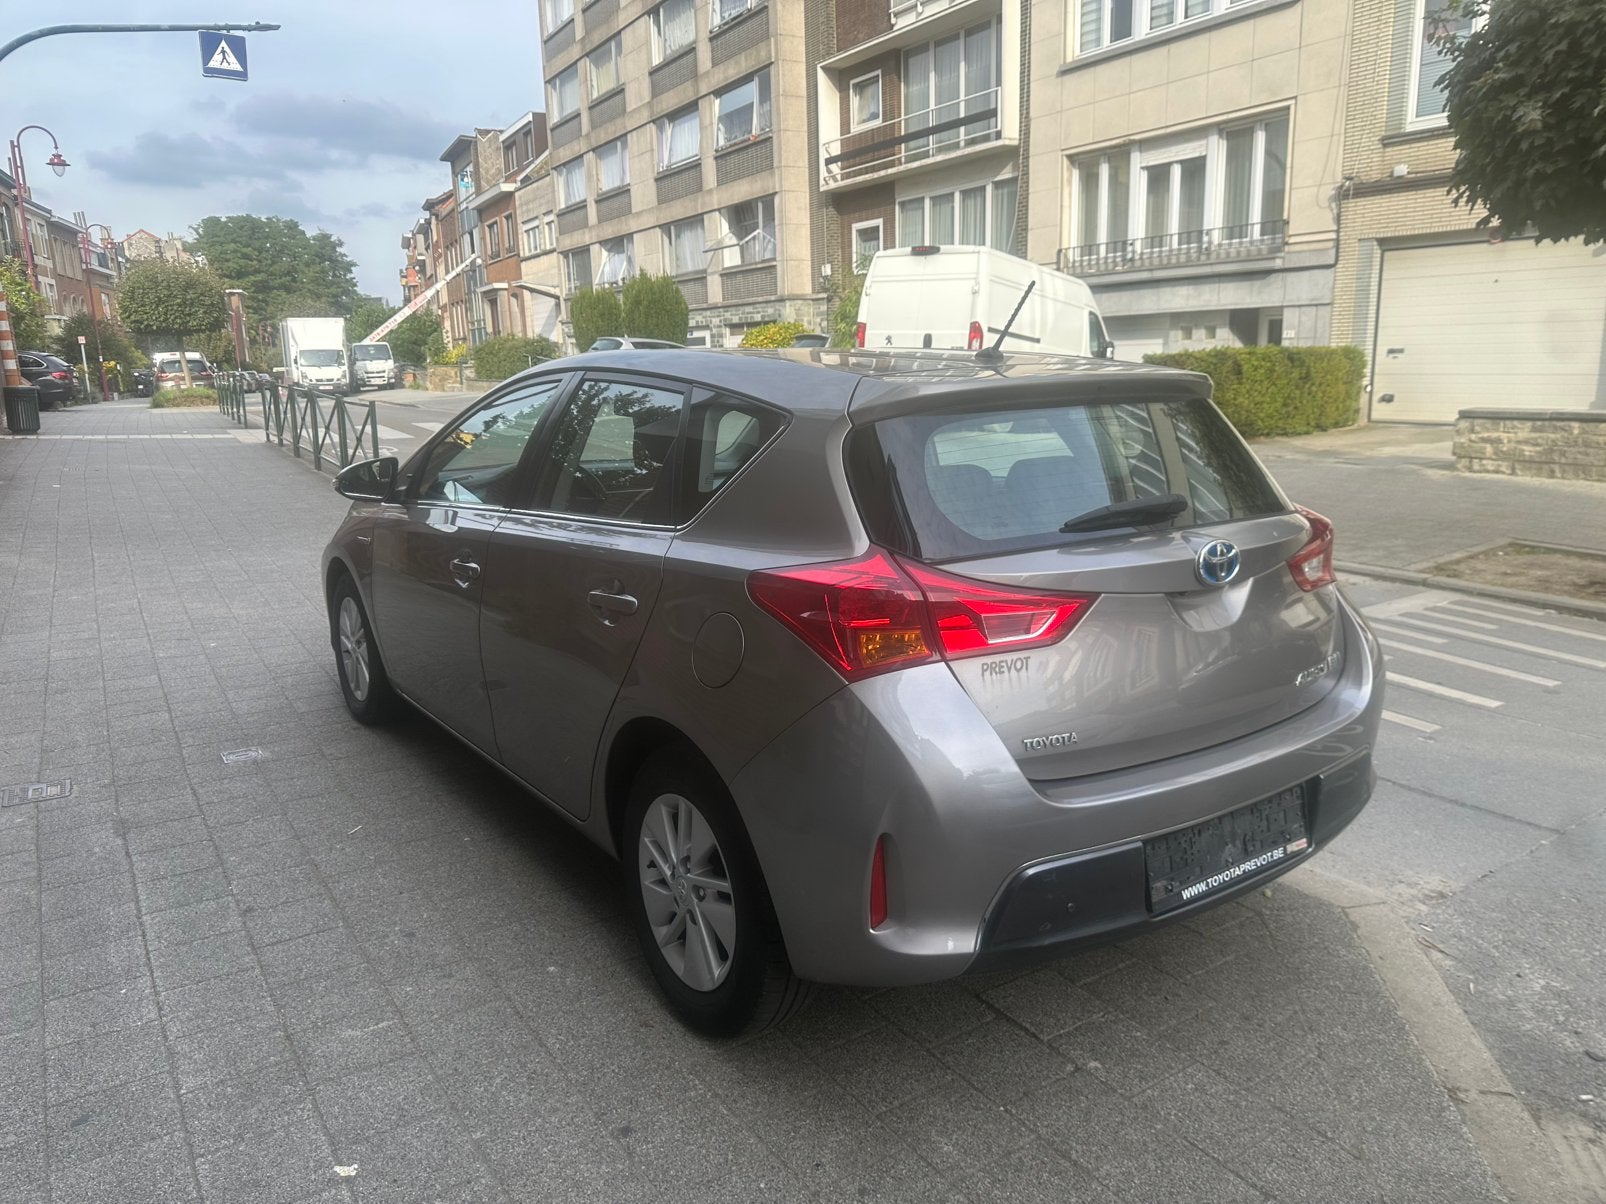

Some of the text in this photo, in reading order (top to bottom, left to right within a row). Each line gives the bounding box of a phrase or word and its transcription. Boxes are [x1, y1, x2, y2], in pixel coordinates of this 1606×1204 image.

[981, 656, 1031, 677] PREVOT
[1022, 732, 1078, 752] TOYOTA
[1181, 847, 1285, 900] WWW.TOYOTAPREVOT.BE
